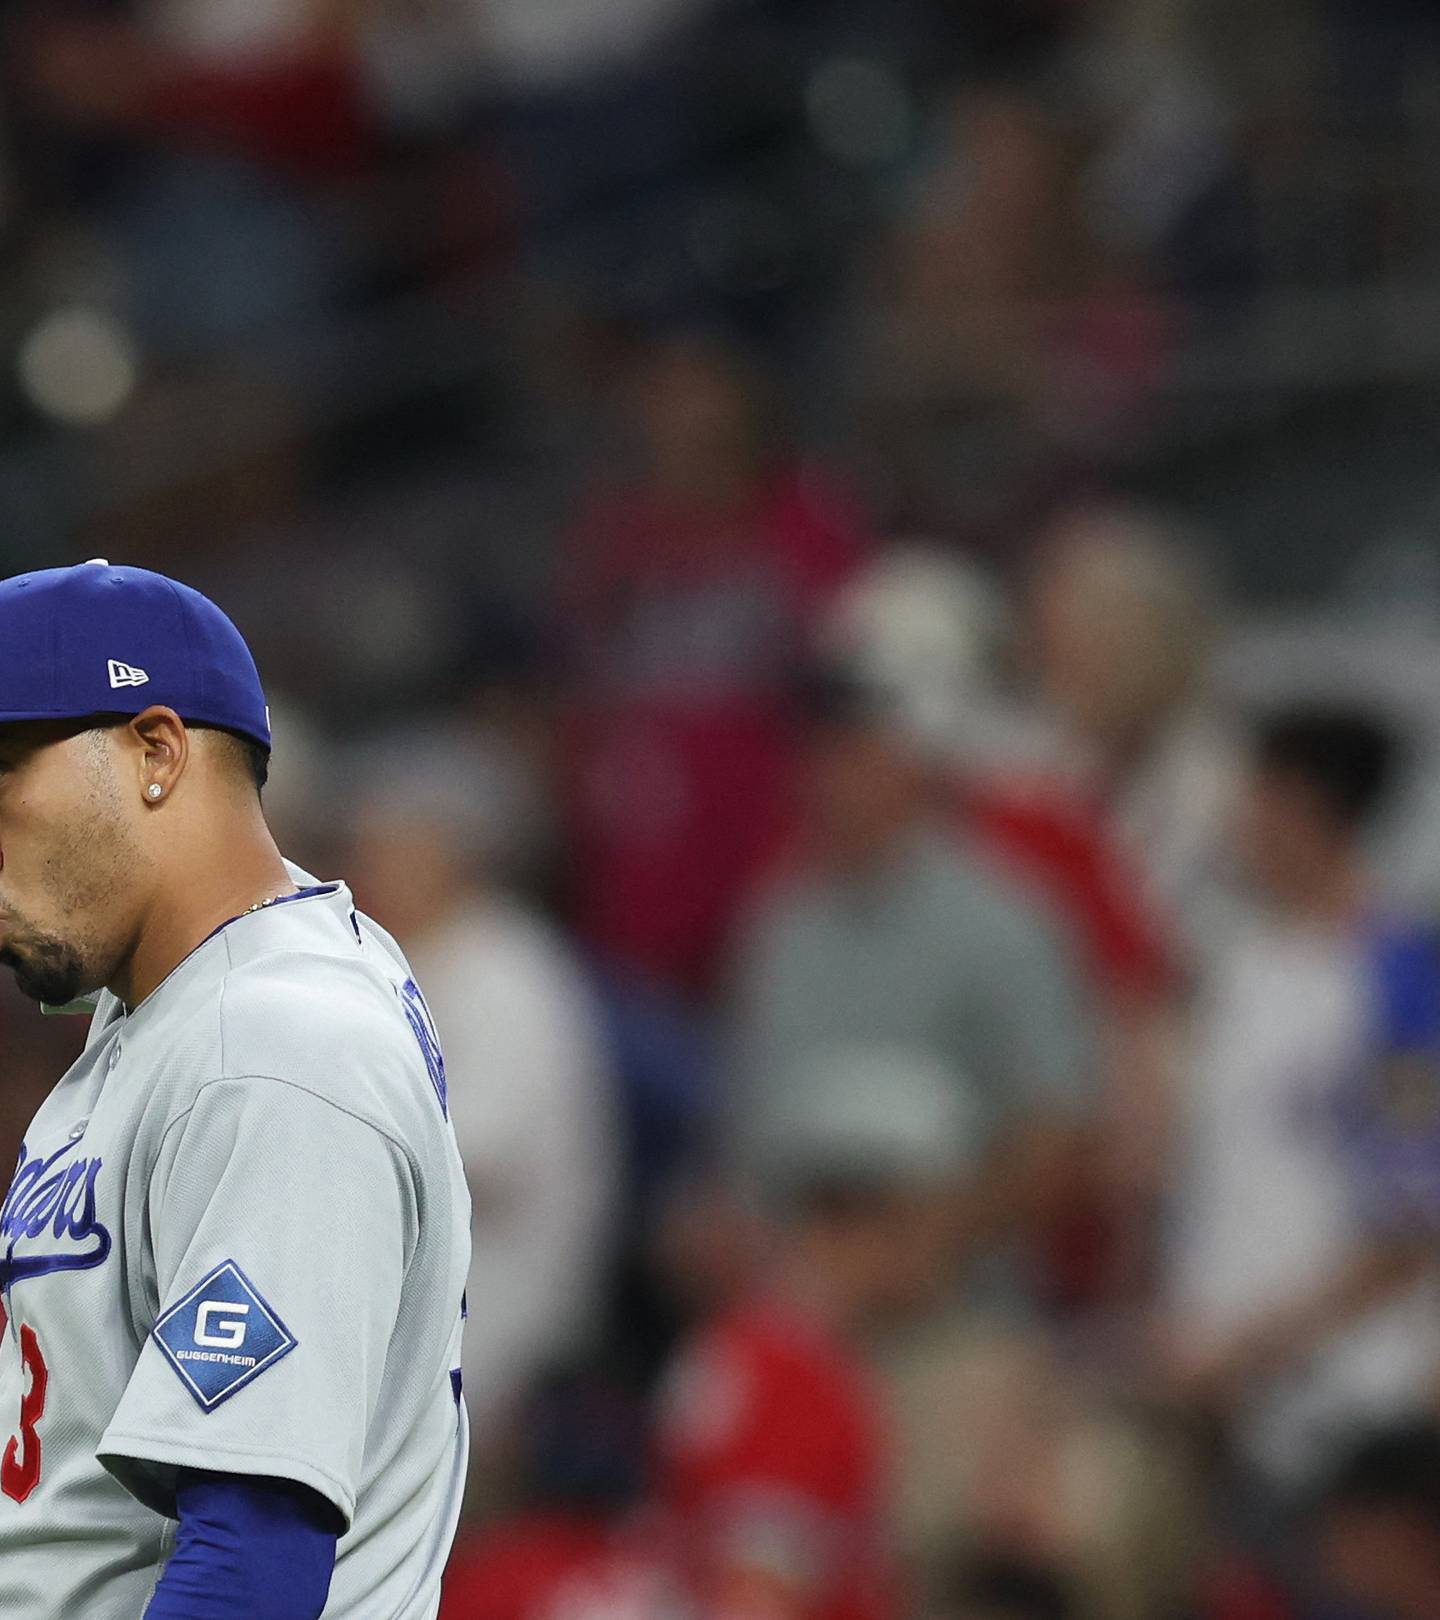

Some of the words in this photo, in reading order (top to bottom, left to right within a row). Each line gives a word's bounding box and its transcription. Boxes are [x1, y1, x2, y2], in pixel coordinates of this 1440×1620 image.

[194, 1301, 249, 1348] G
[176, 1350, 256, 1367] GUGGENHEIM
[0, 1323, 48, 1504] 3
